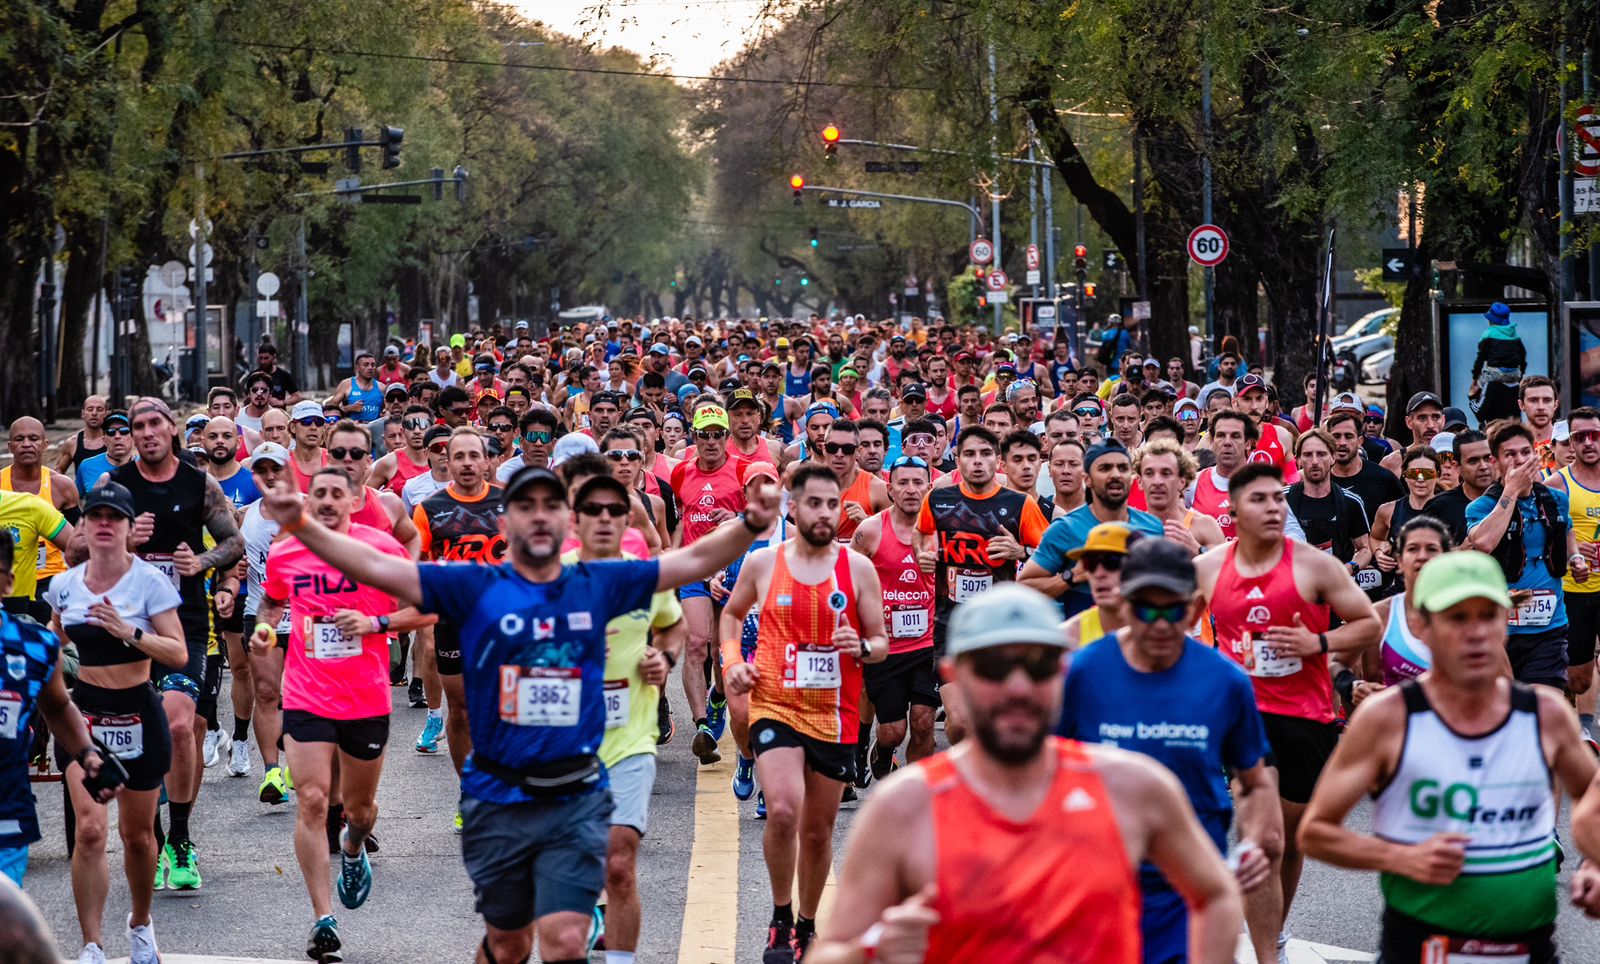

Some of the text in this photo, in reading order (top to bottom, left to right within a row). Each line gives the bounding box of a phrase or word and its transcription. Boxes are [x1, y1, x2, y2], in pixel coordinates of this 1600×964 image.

[1580, 198, 1585, 206] 7
[975, 246, 989, 256] 60
[1197, 236, 1220, 254] 60
[294, 573, 359, 597] FILA
[962, 579, 987, 592] 5075
[883, 589, 930, 600] telecom
[902, 613, 920, 626] 1011
[785, 643, 796, 663] C
[808, 657, 834, 672] 1128
[503, 668, 517, 694] D
[528, 685, 570, 705] 3862
[102, 730, 132, 746] 1766
[1098, 721, 1209, 740] new balance
[1409, 778, 1478, 821] GO
